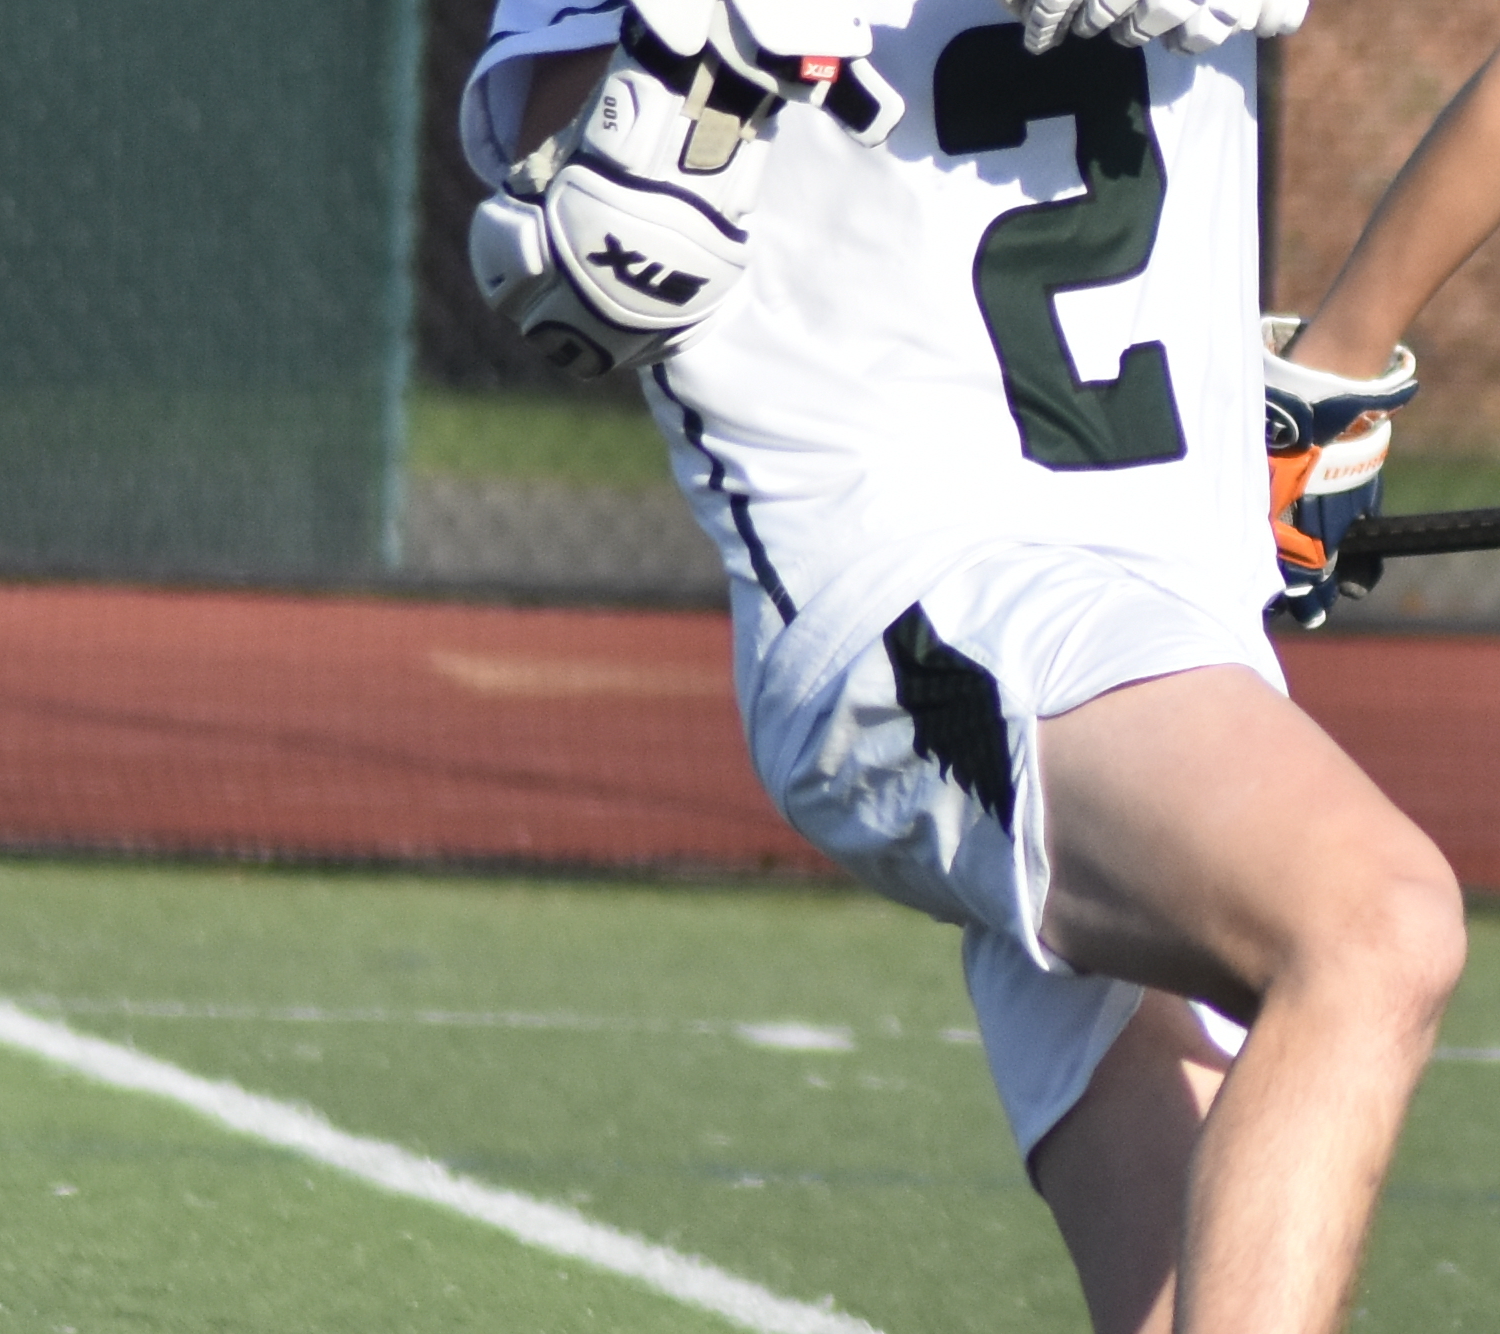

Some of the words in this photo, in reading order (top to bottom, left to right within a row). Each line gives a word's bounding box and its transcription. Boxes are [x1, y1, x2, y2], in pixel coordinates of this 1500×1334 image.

[602, 95, 618, 132] 500
[586, 232, 710, 307] STX
[933, 20, 1188, 472] 2
